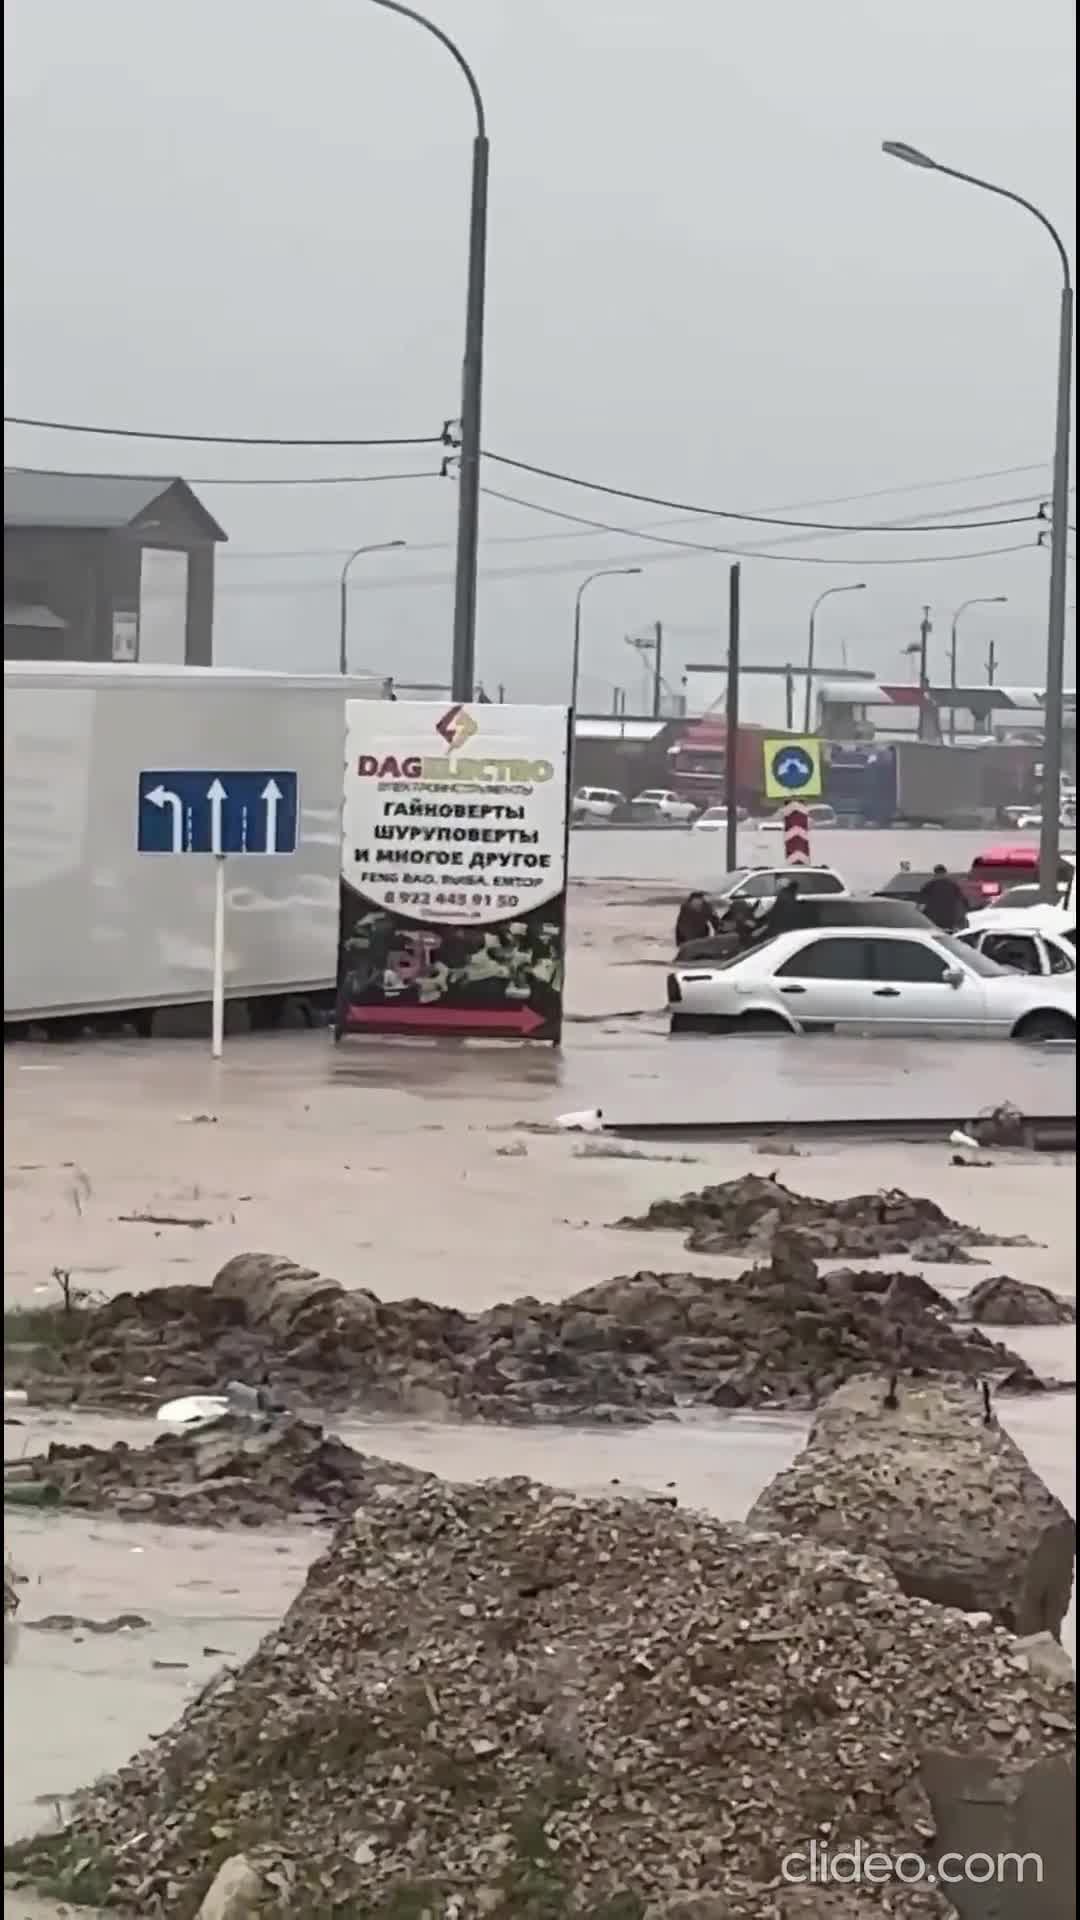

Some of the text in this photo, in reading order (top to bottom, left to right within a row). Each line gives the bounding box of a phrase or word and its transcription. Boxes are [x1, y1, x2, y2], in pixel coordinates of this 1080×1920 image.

[383, 798, 525, 819] ГАЙНОВЕРТЫ
[374, 824, 539, 844] ШУРУПОВЕРТЫ
[354, 848, 552, 870] И МНОГОЕ ДРУГОЕ
